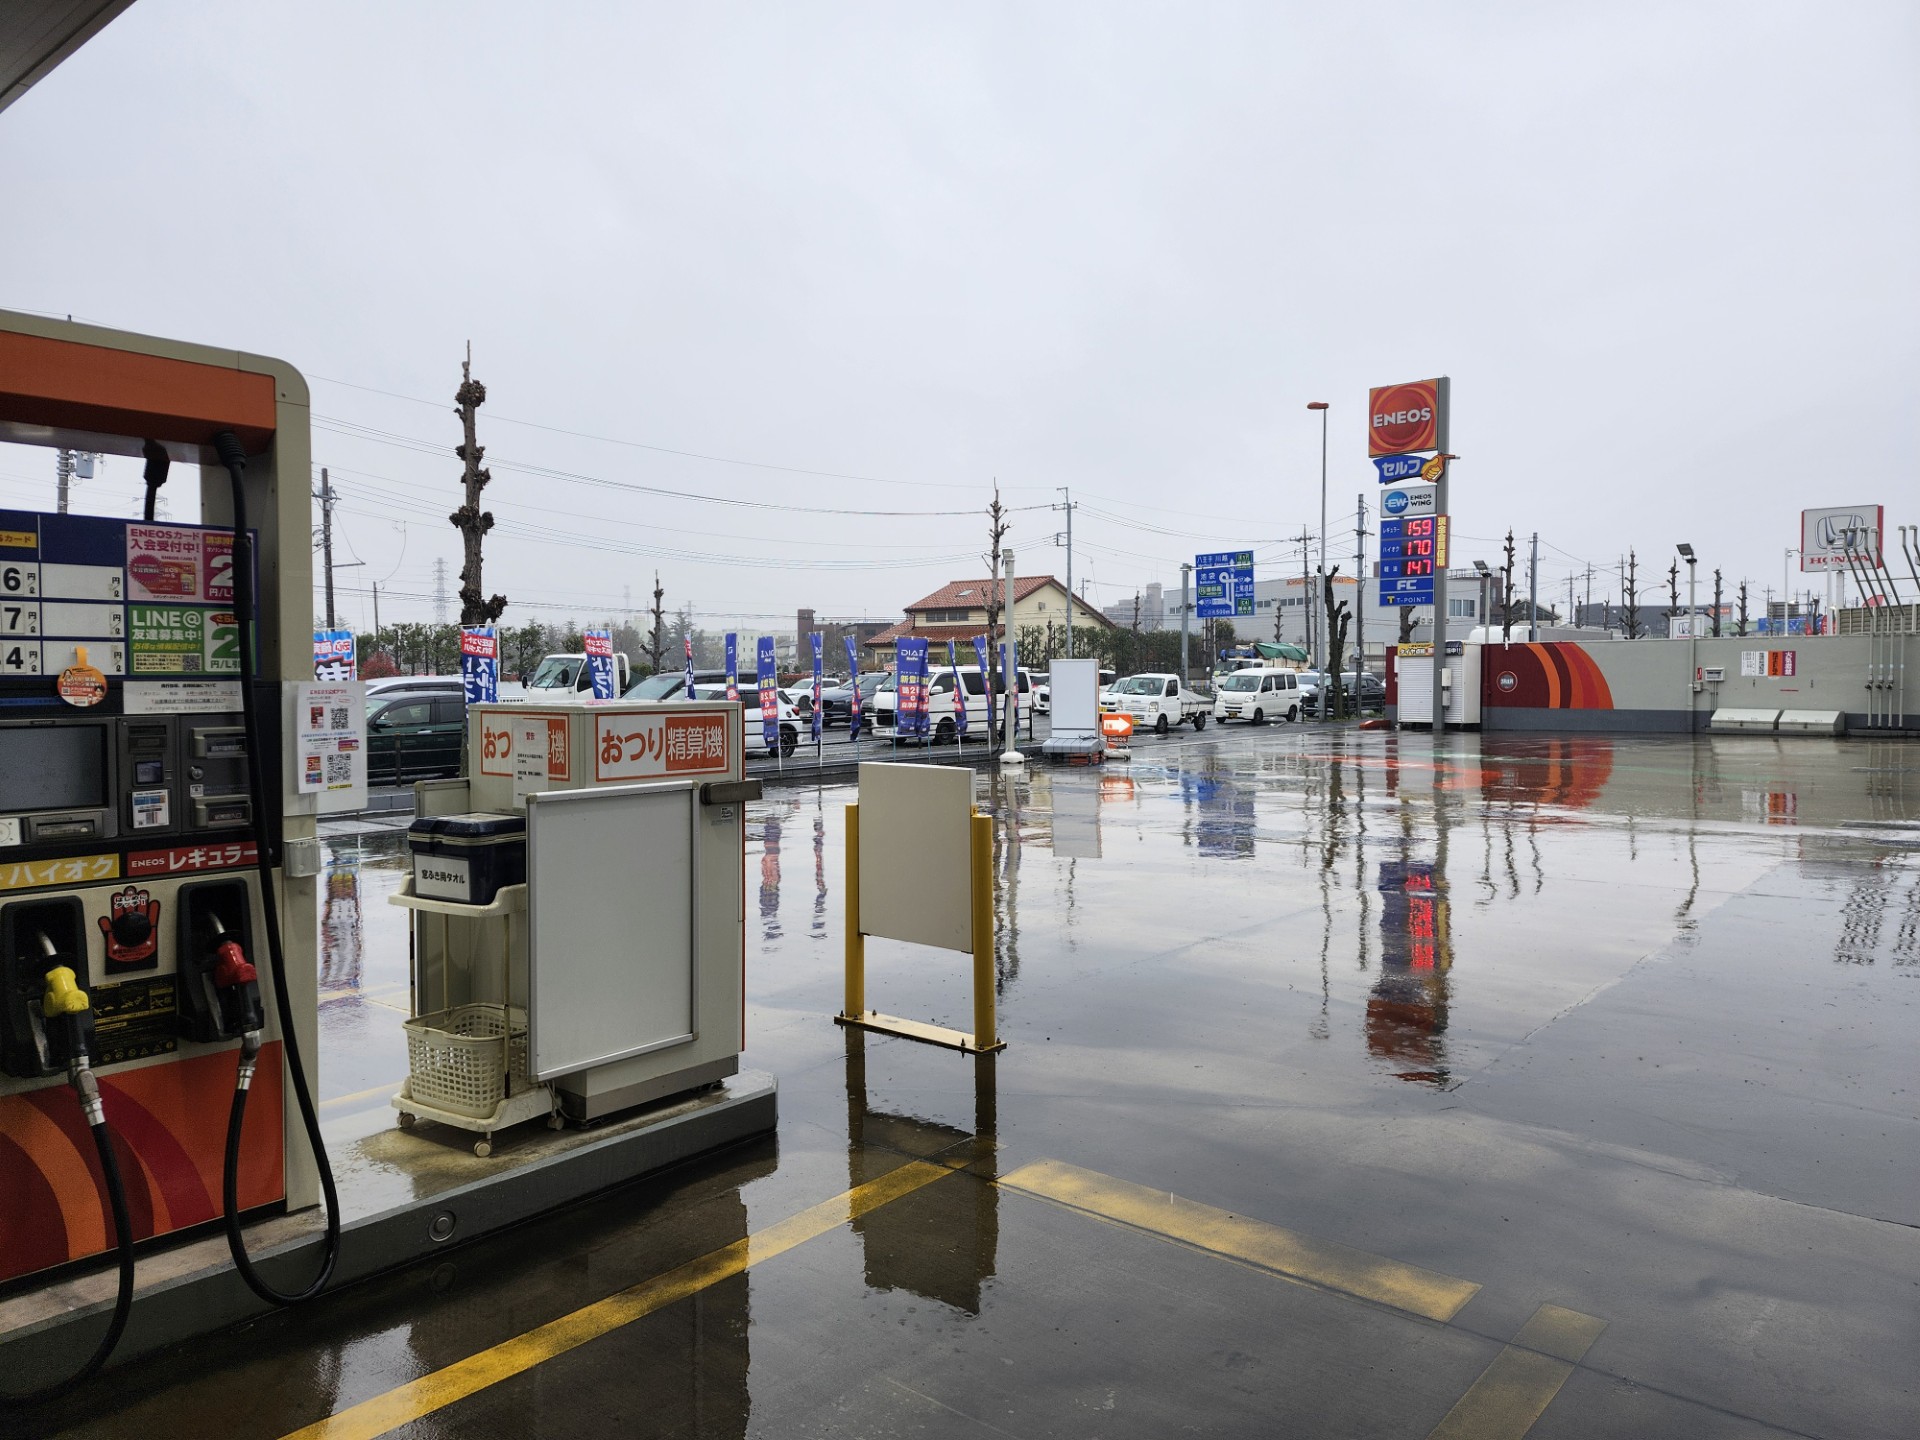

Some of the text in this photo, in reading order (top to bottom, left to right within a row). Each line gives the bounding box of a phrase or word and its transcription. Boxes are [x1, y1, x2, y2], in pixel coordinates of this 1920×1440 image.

[1373, 407, 1431, 428] ENEOS
[1382, 460, 1420, 476] セルフ
[1411, 499, 1432, 507] WING
[130, 528, 199, 540] ENEOSカード
[1407, 519, 1432, 536] 159
[130, 539, 200, 553] 入会受付中!
[1408, 539, 1432, 556] 170
[1407, 560, 1431, 575] 147
[3, 567, 21, 591] 6
[1396, 580, 1417, 590] FC
[4, 607, 21, 630] 7
[132, 610, 201, 628] LINE@
[211, 627, 240, 659] 2
[6, 647, 24, 669] 4
[132, 846, 258, 871] ENEOS レギュラー
[9, 857, 113, 885] ハイオク
